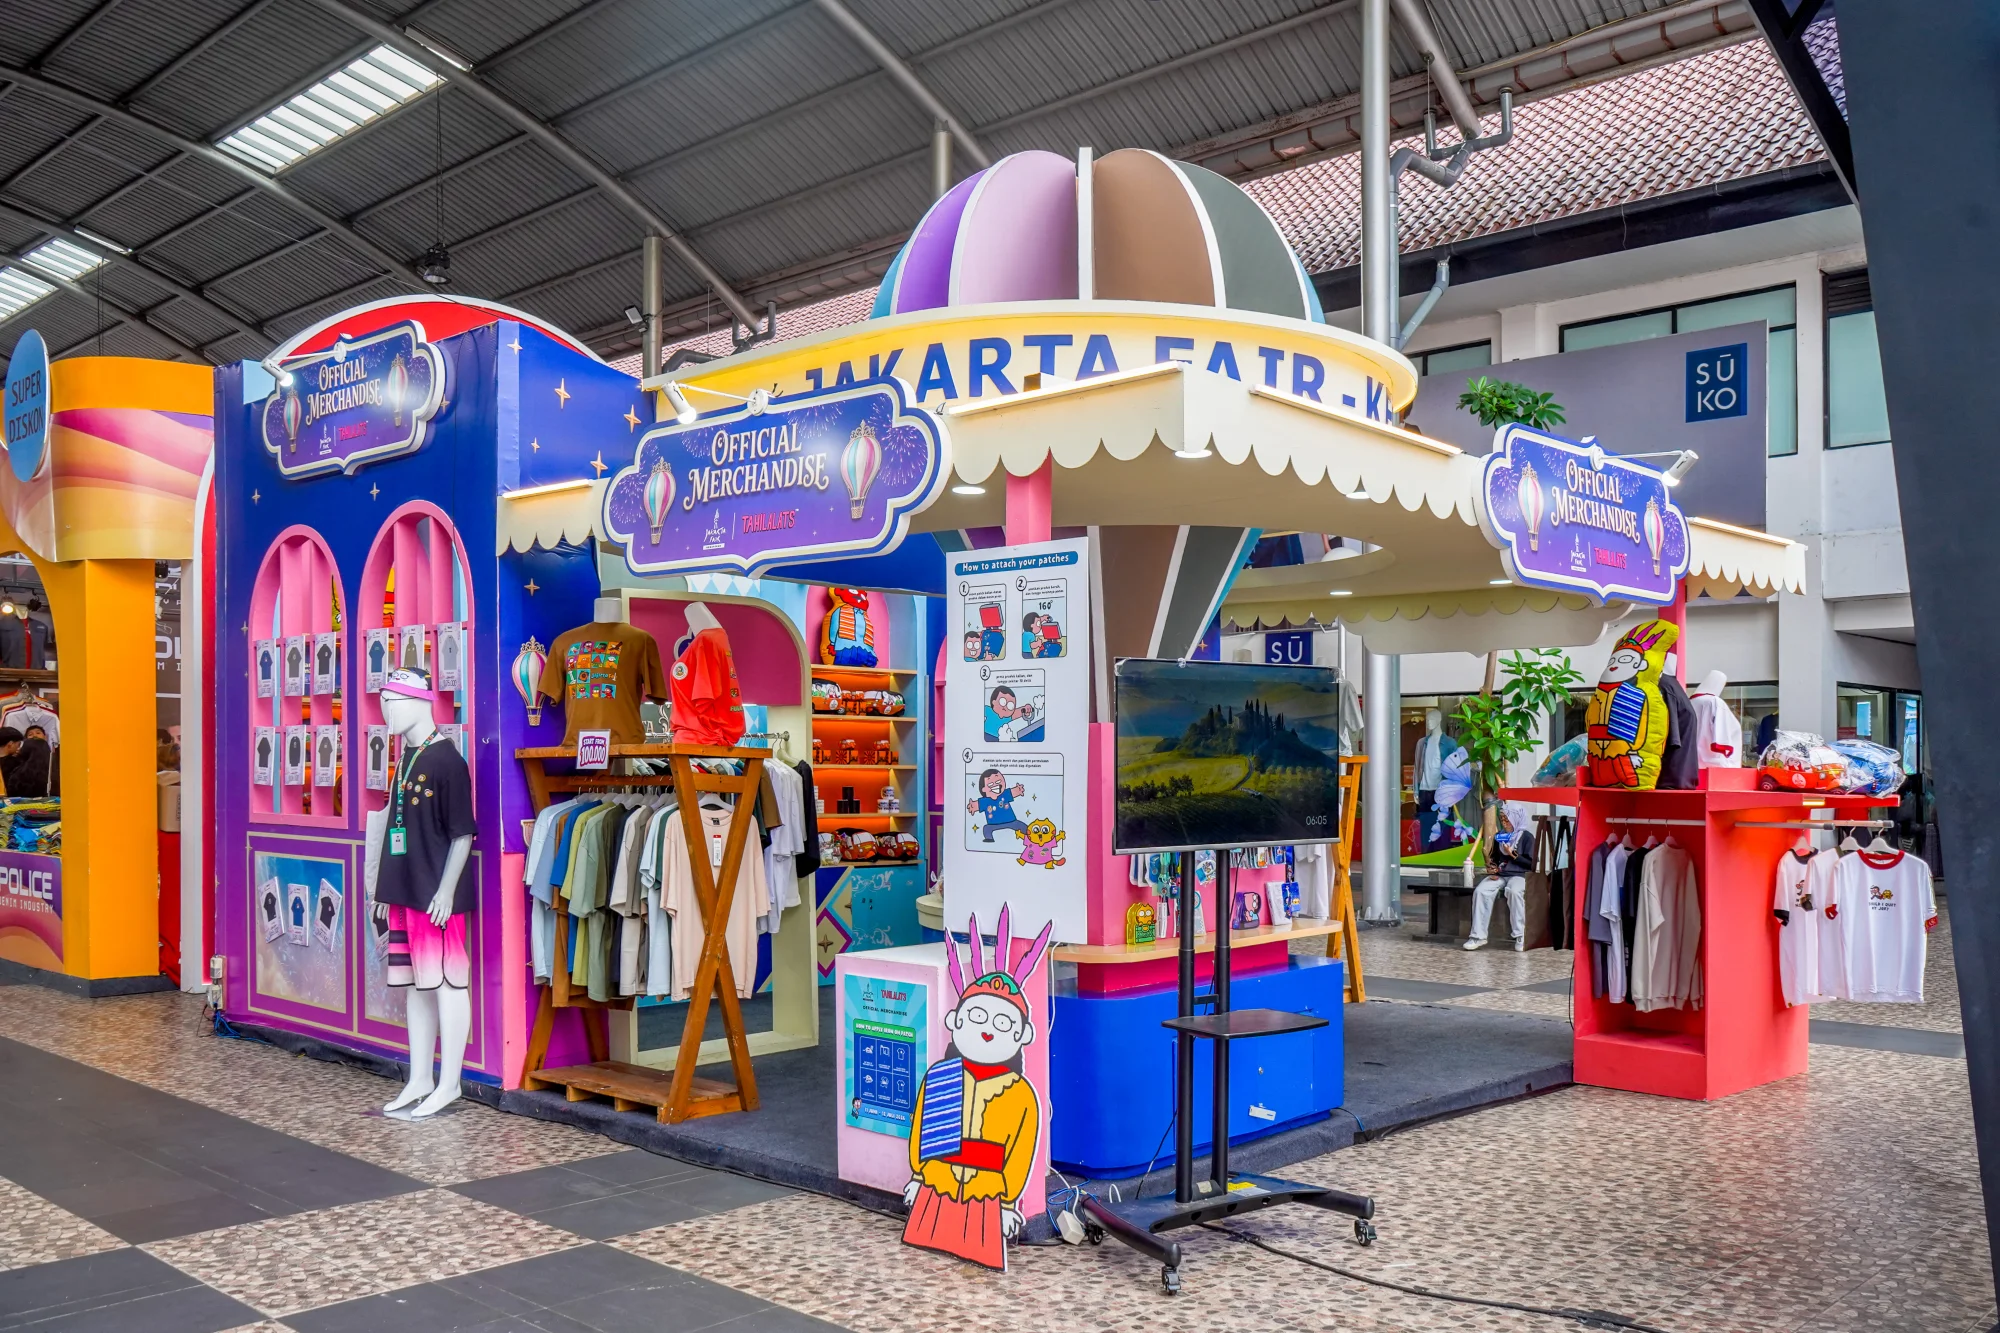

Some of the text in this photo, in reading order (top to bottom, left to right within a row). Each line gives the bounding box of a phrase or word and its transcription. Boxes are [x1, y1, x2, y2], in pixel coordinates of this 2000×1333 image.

[318, 358, 368, 390] OFFICIAL
[1696, 354, 1735, 385] SŪ
[11, 369, 42, 407] SUPER
[305, 376, 383, 427] MERCHANDISE
[1697, 387, 1737, 413] KO
[9, 405, 44, 443] DISKON
[711, 421, 803, 466] OFFICIAL
[683, 452, 830, 512] MERCHANDISE
[1566, 458, 1624, 504] OFFICIAL
[1551, 486, 1641, 545] MERCHANDISE
[962, 554, 1070, 572] How to attach your patches
[1018, 579, 1025, 588] 2.
[981, 668, 989, 678] 3.
[581, 745, 606, 765] 100.000
[595, 738, 605, 746] FROM
[964, 751, 971, 760] 4.
[1305, 814, 1328, 826] 06:05
[0, 866, 53, 900] POLICE
[20, 900, 54, 914] INDUSTRY
[880, 1008, 908, 1017] MERCHANDISE
